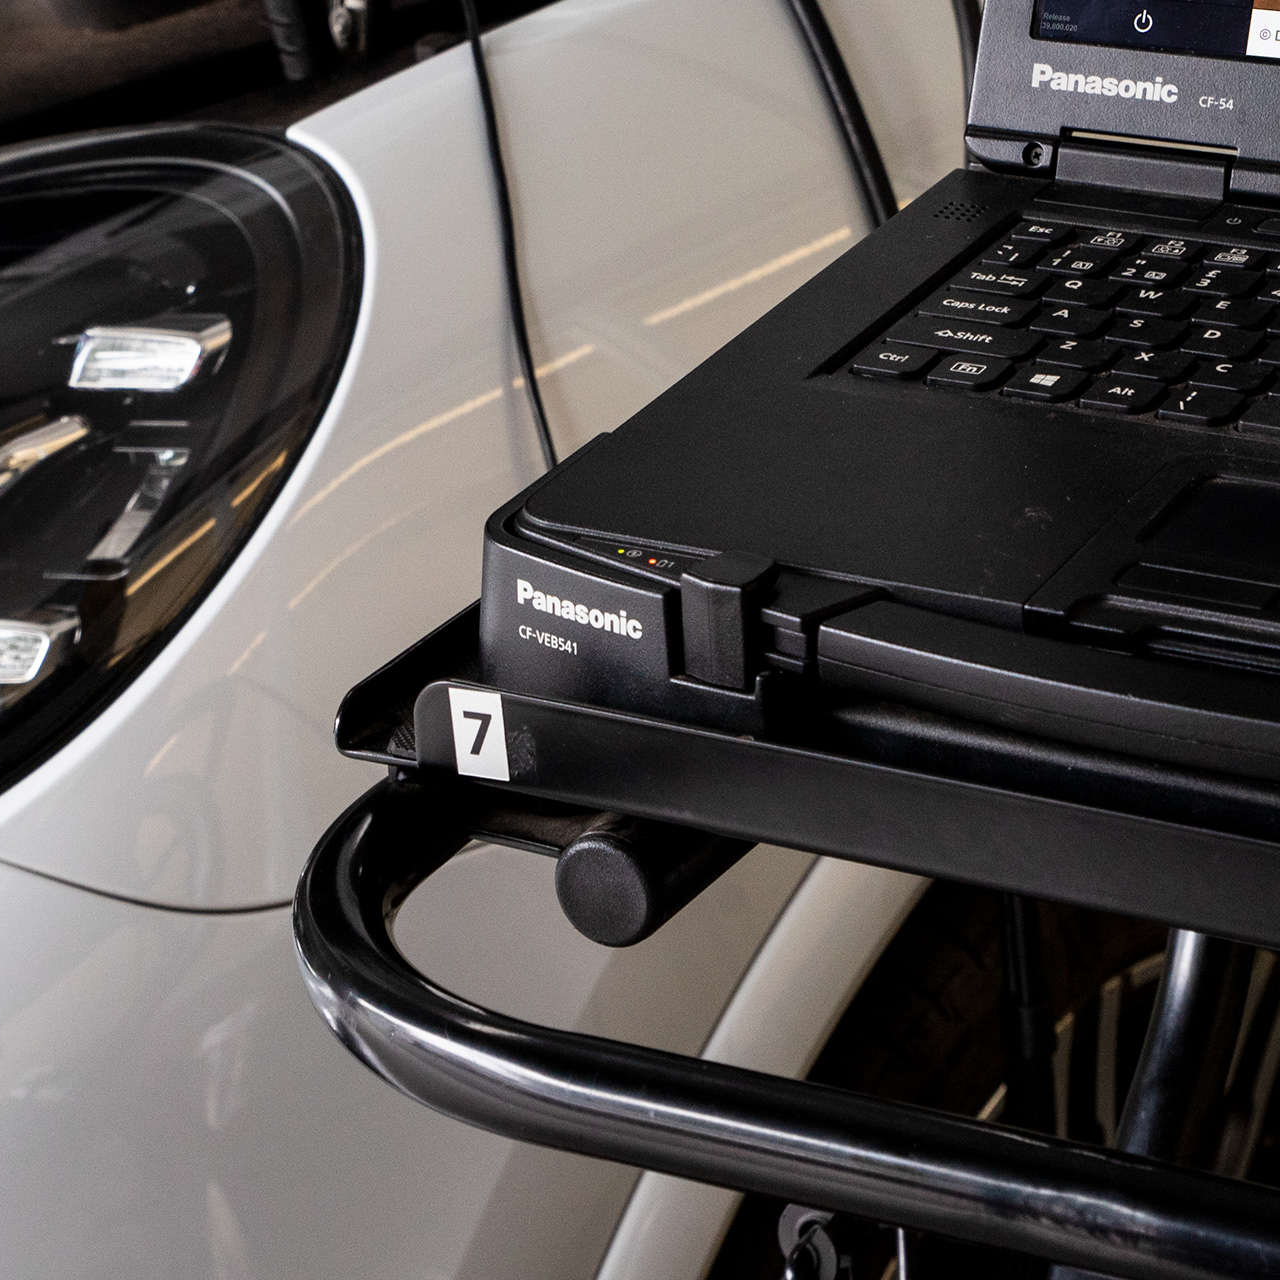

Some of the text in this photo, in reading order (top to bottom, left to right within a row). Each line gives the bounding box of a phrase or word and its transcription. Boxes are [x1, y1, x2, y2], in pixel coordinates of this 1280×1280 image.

[1043, 12, 1071, 22] Release
[1031, 62, 1179, 103] Panasonic
[1199, 95, 1234, 110] CF-54
[1028, 226, 1054, 234] Esc
[970, 272, 996, 282] Tab
[1121, 268, 1137, 277] 2
[1064, 280, 1083, 290] Q
[1195, 278, 1212, 287] 3
[1139, 289, 1164, 300] W
[942, 299, 1011, 314] Caps Lock
[1215, 300, 1231, 309] E
[1051, 309, 1069, 319] A
[1129, 319, 1145, 328] S
[954, 331, 993, 344] Shift
[1203, 330, 1222, 339] D
[1059, 340, 1078, 350] Z
[878, 352, 910, 362] Ctrl
[1133, 351, 1155, 362] X
[959, 365, 978, 373] Fn
[1215, 363, 1234, 373] C
[1107, 386, 1136, 397] Alt
[516, 578, 643, 639] Panasonic
[518, 625, 578, 655] CF-VEB541
[462, 710, 492, 756] 7
